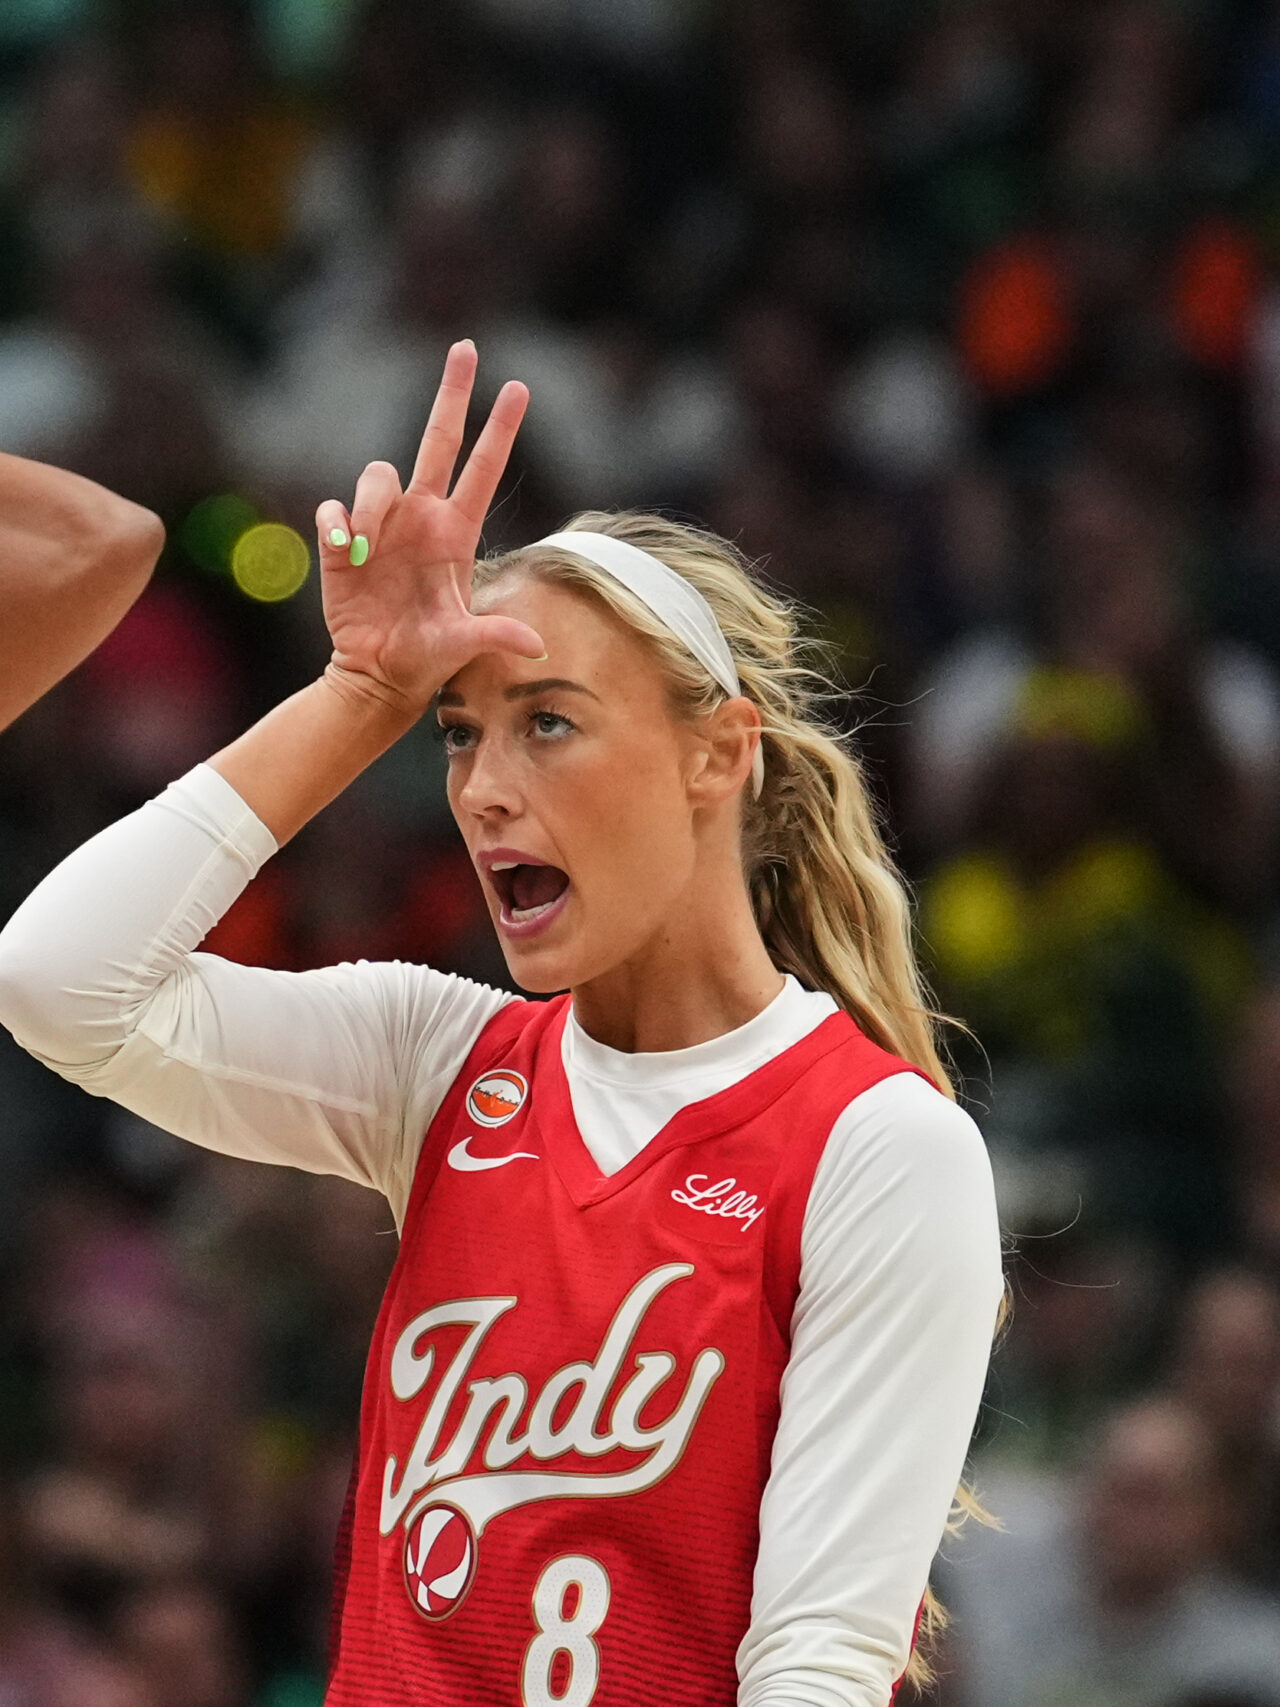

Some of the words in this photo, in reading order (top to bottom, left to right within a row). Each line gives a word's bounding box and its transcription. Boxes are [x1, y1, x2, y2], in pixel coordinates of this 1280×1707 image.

[670, 1173, 766, 1232] Lilly
[379, 1262, 725, 1538] Indy
[521, 1552, 611, 1707] 8
